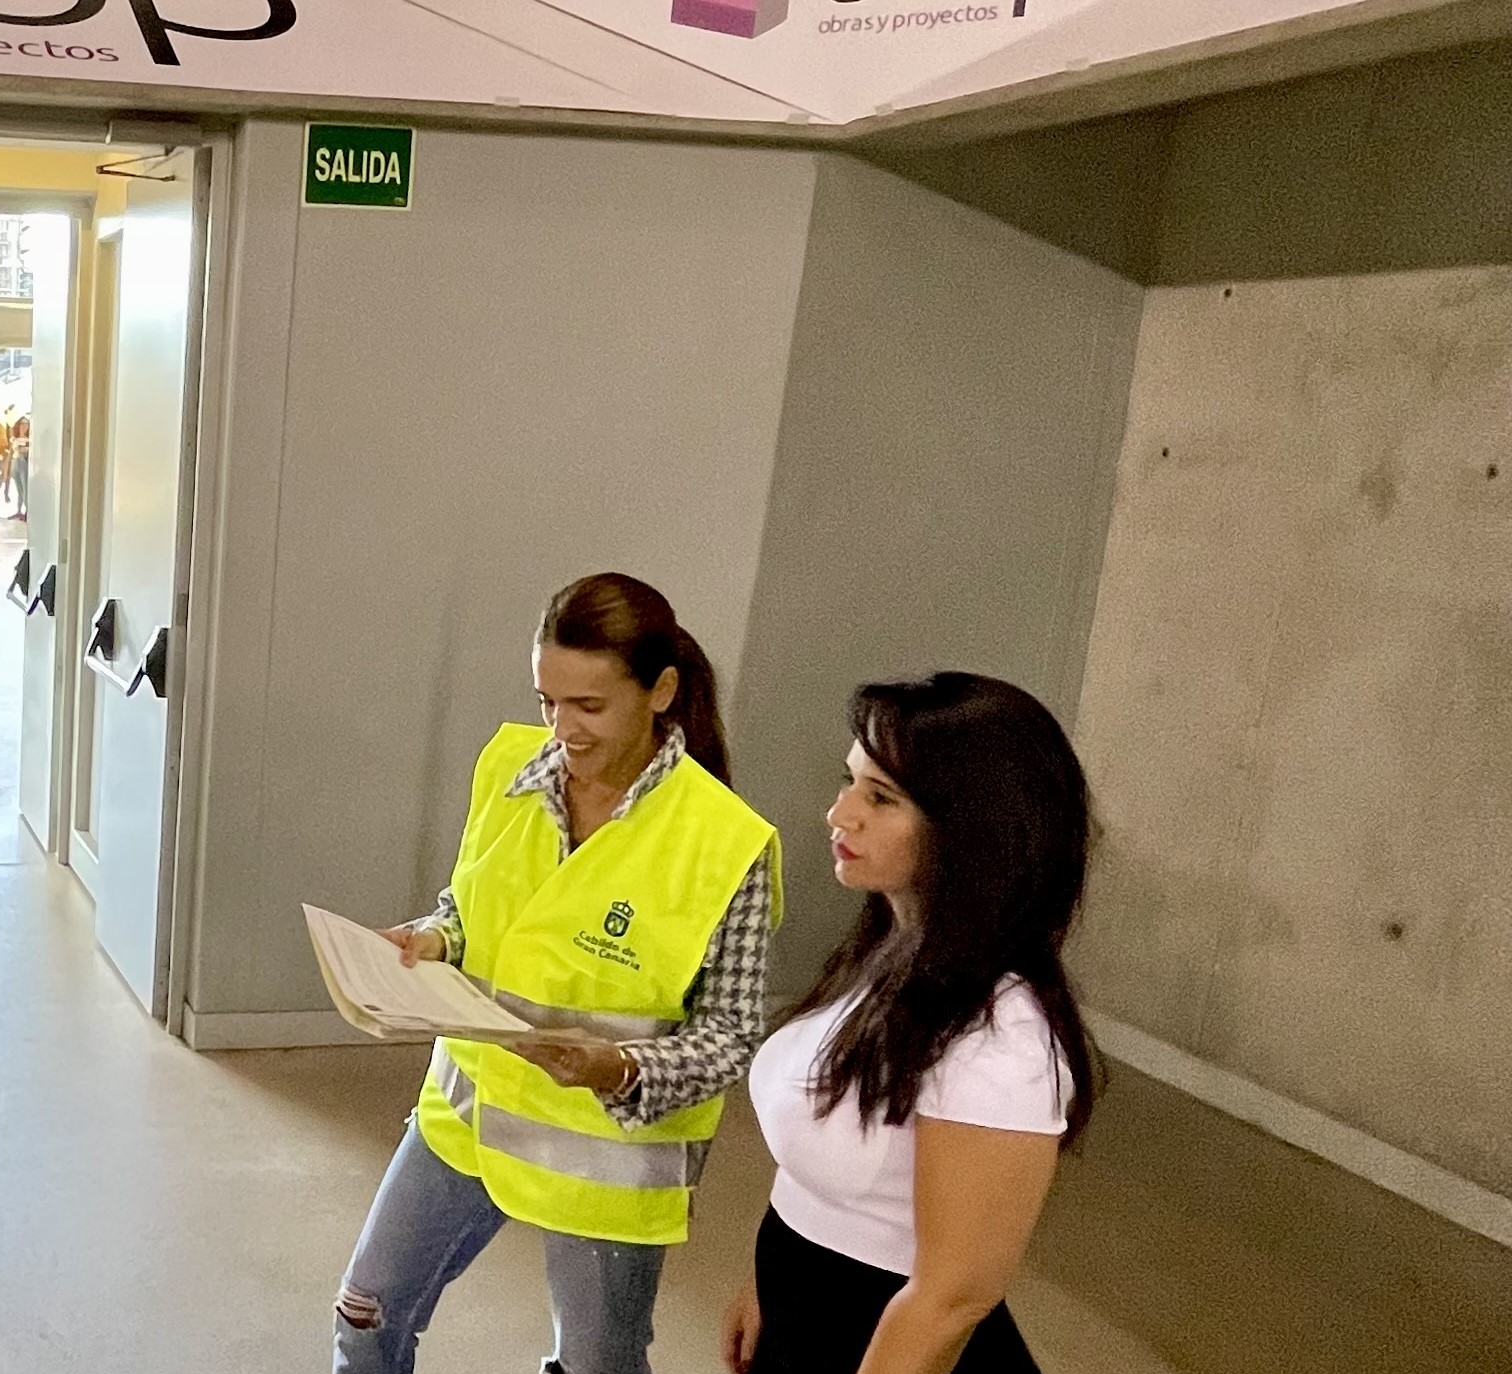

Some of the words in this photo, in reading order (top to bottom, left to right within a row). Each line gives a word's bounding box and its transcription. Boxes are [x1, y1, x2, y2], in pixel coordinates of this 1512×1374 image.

[818, 14, 874, 33] obras
[876, 14, 890, 33] y
[891, 5, 999, 32] proyectos
[314, 146, 401, 185] SALIDA
[572, 936, 596, 955] Gran
[598, 949, 641, 971] Canaria
[579, 930, 620, 951] Cabildo
[621, 946, 637, 958] de
